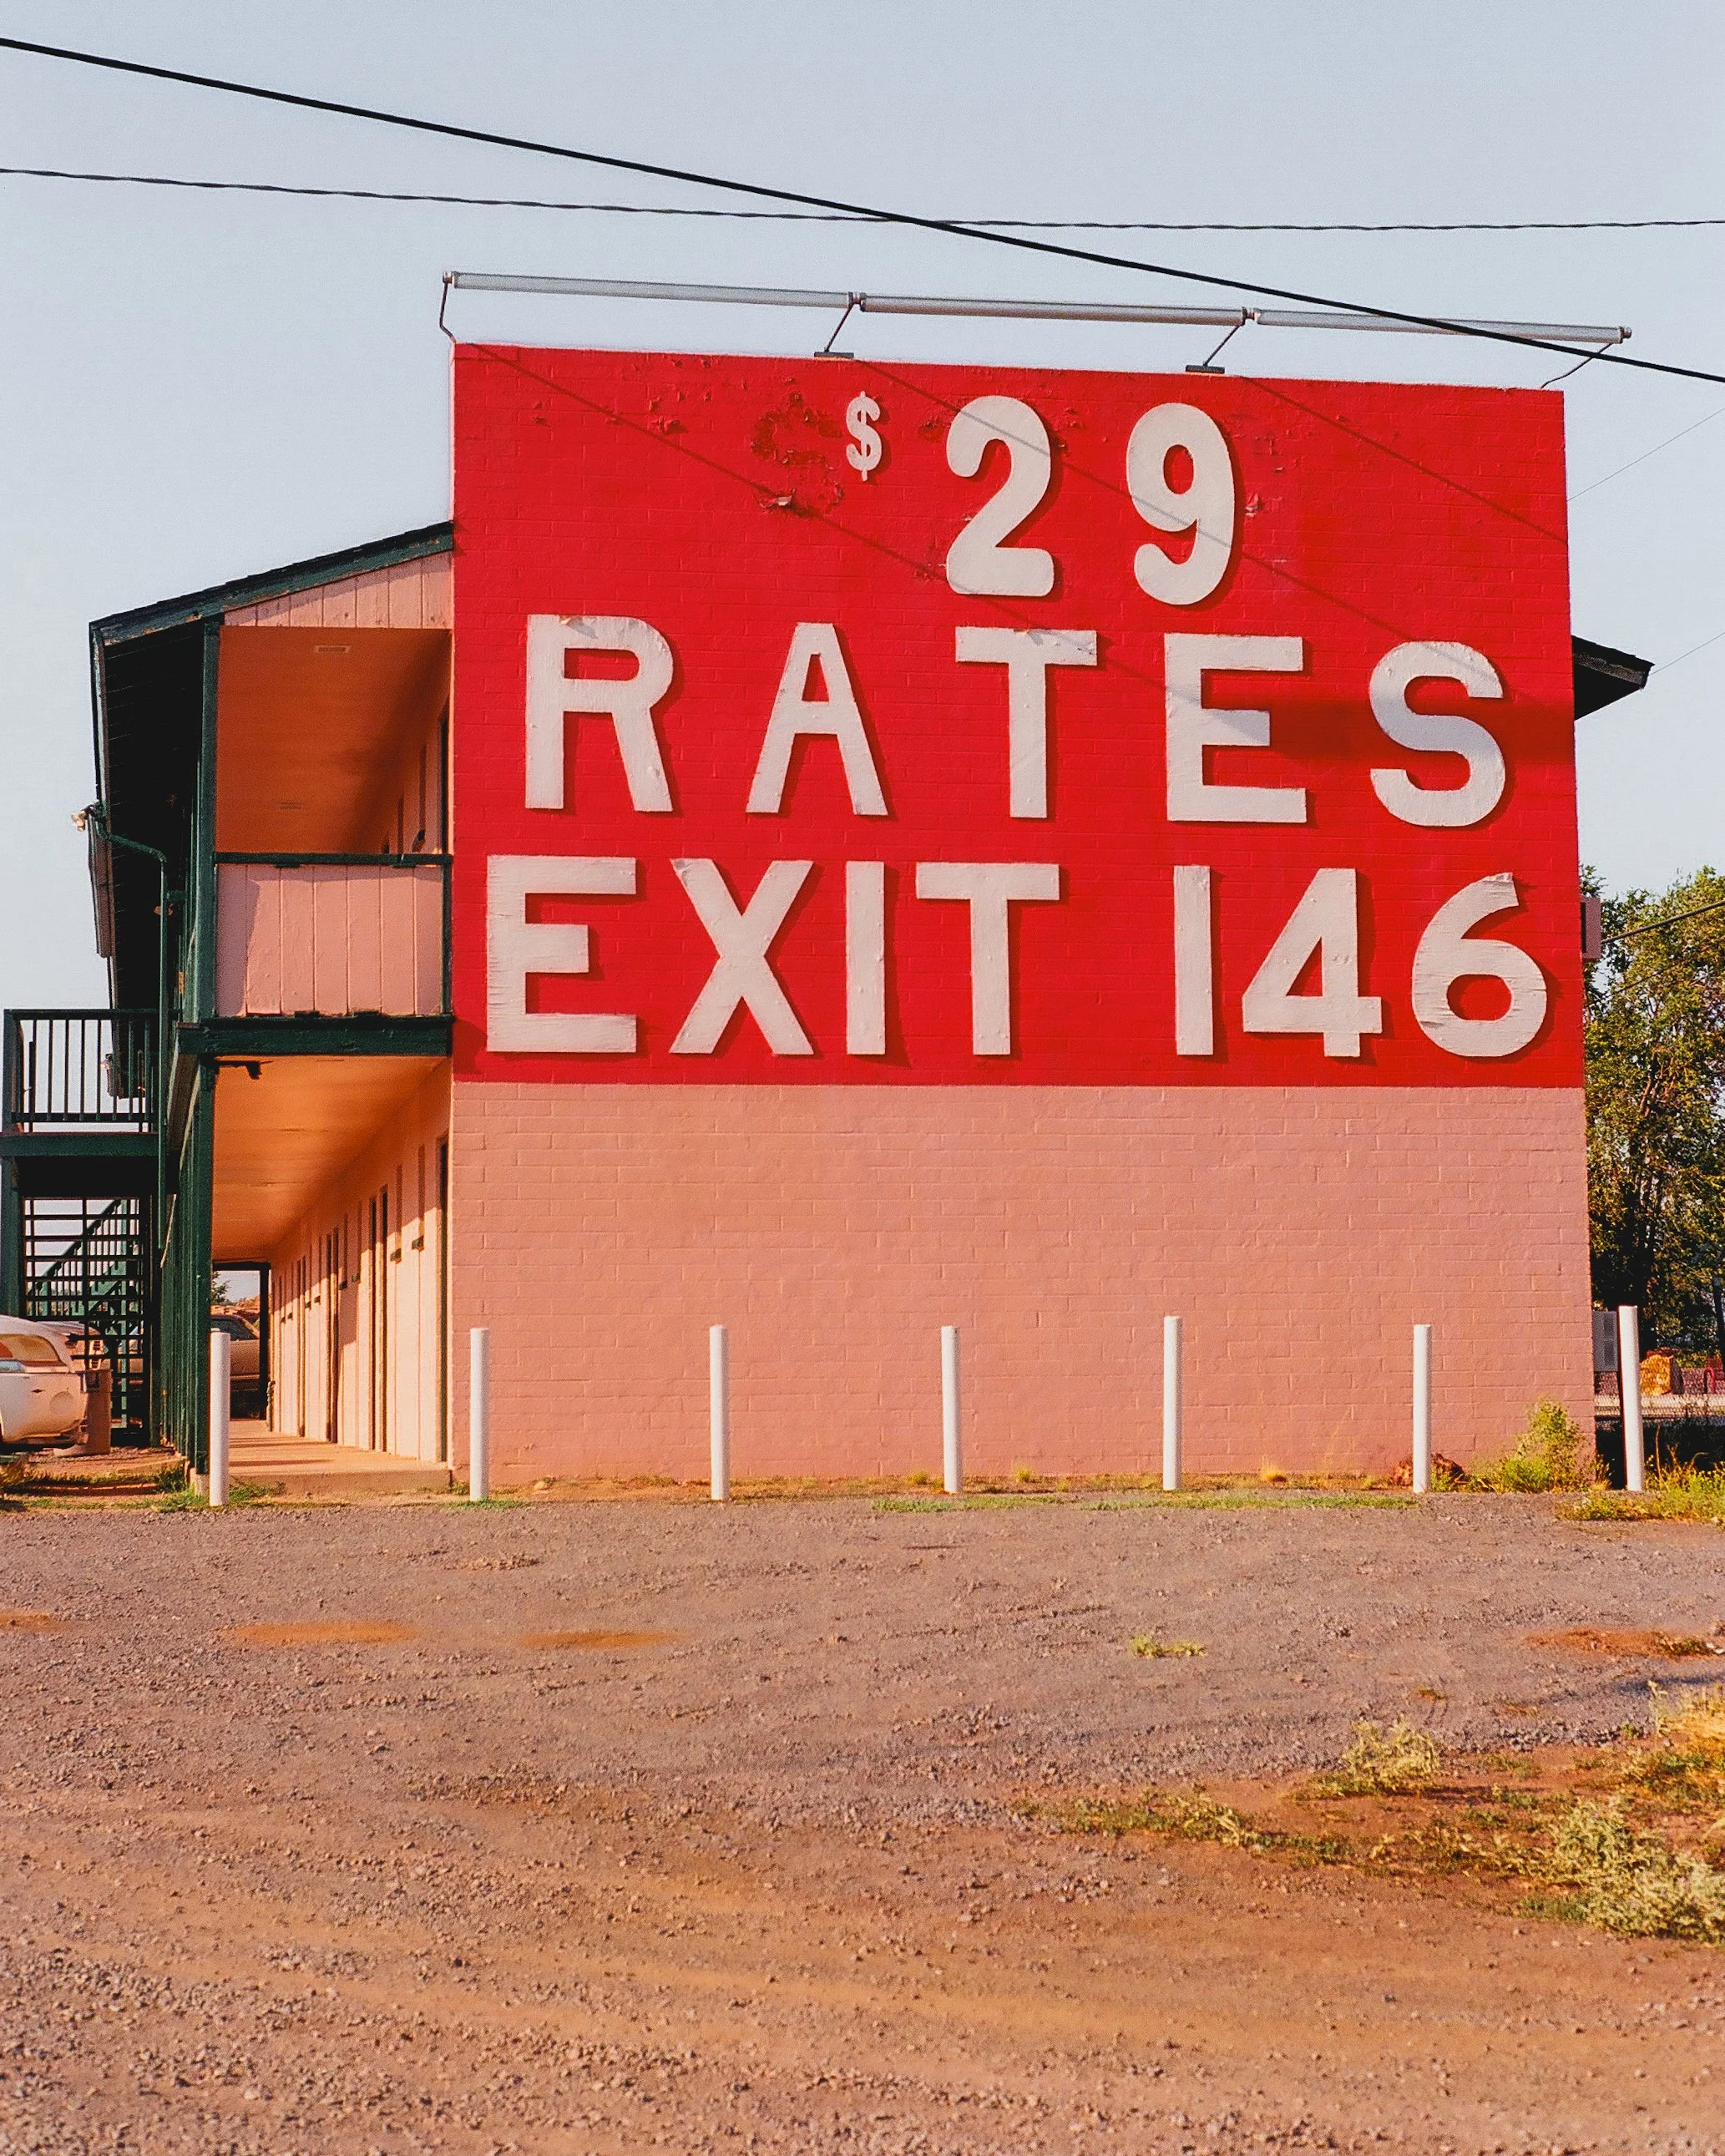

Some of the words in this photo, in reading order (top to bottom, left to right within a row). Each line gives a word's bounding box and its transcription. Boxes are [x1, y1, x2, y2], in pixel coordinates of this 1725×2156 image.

[524, 613, 1508, 828] RATES
[486, 854, 1060, 1058] EXIT
[1172, 865, 1550, 1060] 146
